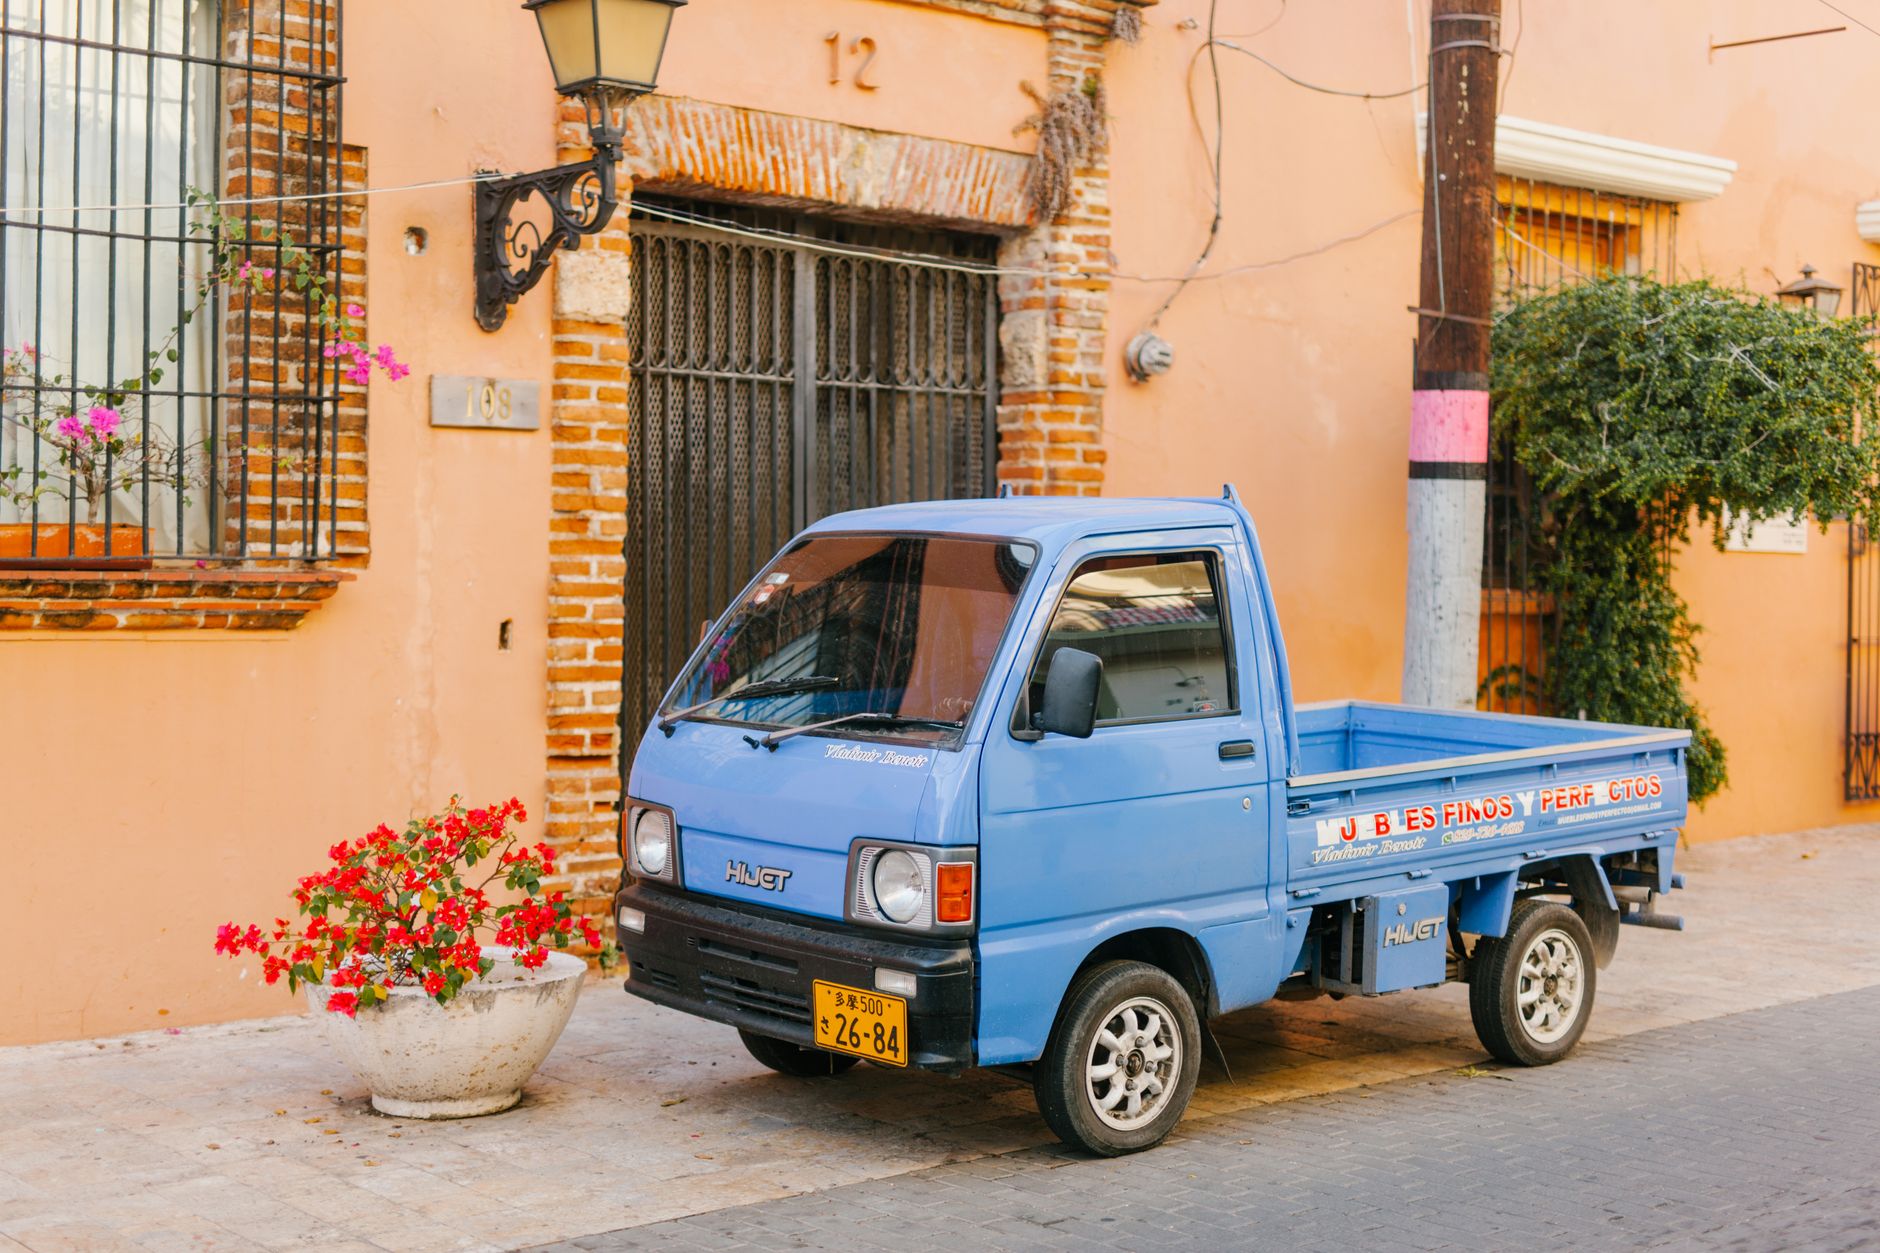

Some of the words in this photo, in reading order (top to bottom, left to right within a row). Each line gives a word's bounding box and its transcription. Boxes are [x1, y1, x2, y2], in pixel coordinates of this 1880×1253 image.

[823, 31, 881, 92] 12
[465, 384, 512, 420] 108
[1442, 795, 1513, 828] FINOS
[1516, 791, 1535, 816] Y
[835, 1012, 900, 1059] 26-84
